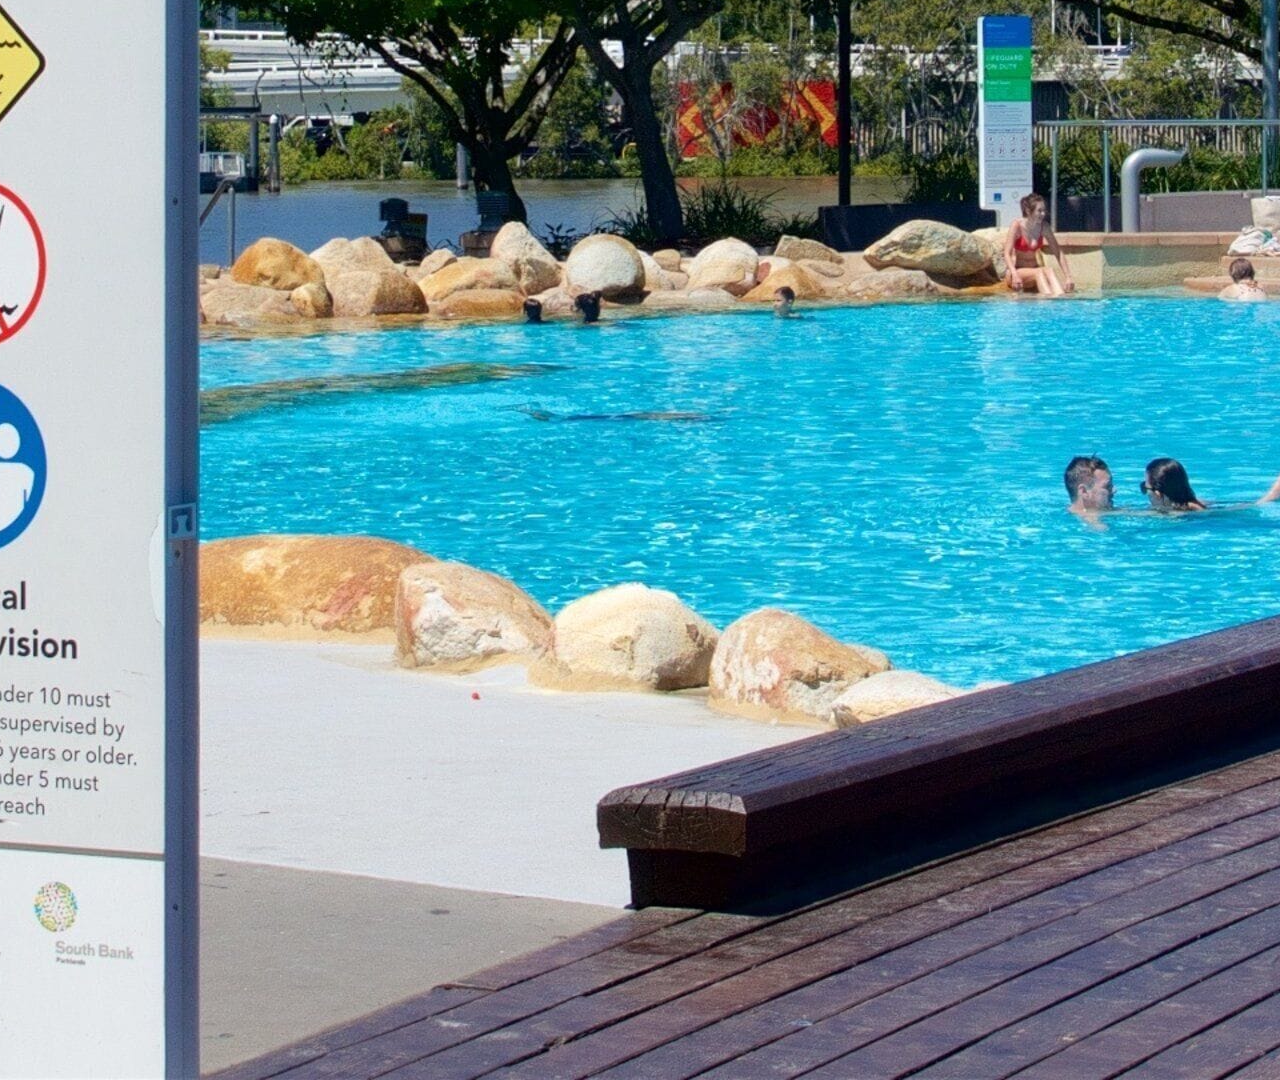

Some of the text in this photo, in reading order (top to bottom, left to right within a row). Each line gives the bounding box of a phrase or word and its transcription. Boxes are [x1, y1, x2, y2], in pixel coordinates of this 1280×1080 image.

[40, 686, 62, 706] 10
[67, 691, 111, 708] must
[0, 716, 97, 736] supervised
[103, 717, 125, 743] by
[9, 746, 57, 764] years
[61, 748, 81, 762] or
[85, 745, 138, 767] older.
[38, 769, 49, 788] 5
[55, 775, 99, 792] must
[55, 940, 134, 960] South Bank
